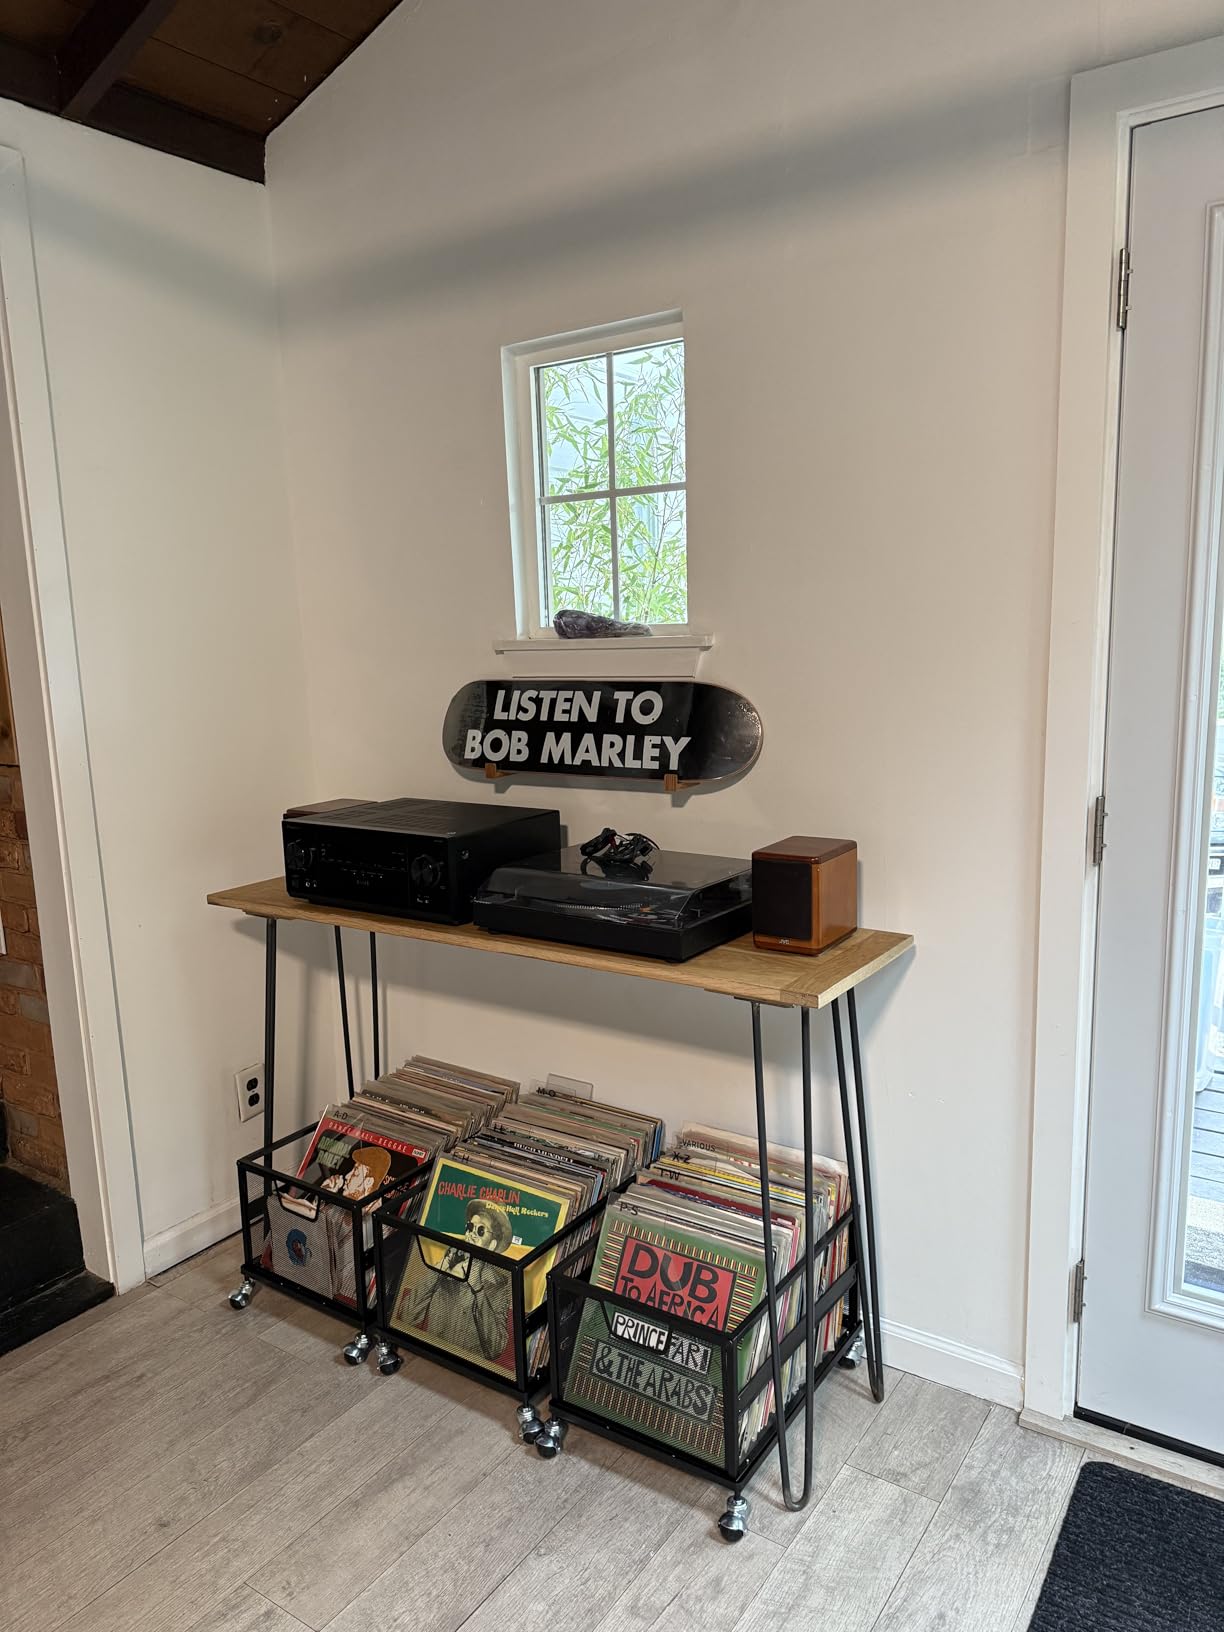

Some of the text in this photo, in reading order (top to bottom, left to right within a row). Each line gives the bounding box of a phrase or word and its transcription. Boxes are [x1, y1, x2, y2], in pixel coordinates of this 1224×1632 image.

[493, 689, 663, 725] LISTEN TO
[463, 729, 691, 770] BOB MARLEY
[333, 1110, 348, 1120] A-D
[682, 1139, 716, 1152] VARIOUS
[437, 1181, 521, 1205] CHARLIE CHAPLIN
[506, 1204, 520, 1216] Hall
[521, 1206, 549, 1218] Rockers
[620, 1203, 639, 1216] P-S
[628, 1243, 719, 1303] DUB
[643, 1280, 719, 1330] AFRICA
[613, 1314, 666, 1350] PRINCE
[595, 1346, 711, 1416] & THE ARABS
